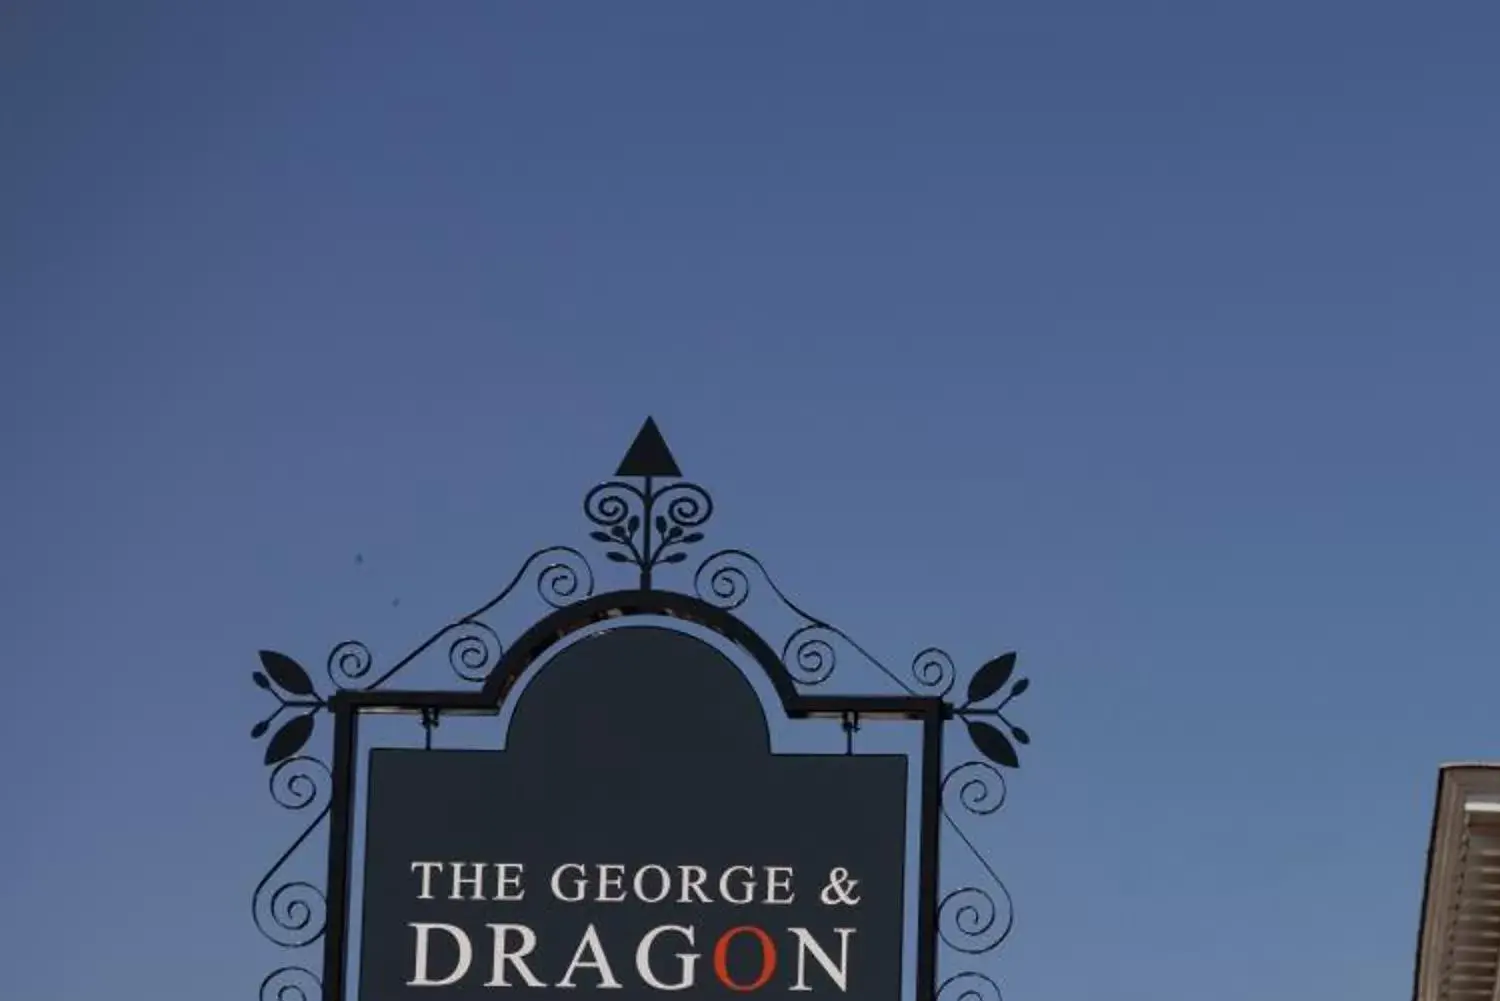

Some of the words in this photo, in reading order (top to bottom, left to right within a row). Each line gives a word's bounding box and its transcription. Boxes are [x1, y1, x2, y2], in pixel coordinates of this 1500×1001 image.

[411, 861, 525, 900] THE
[550, 863, 795, 905] GEORGE
[820, 866, 861, 906] &
[406, 922, 857, 992] DRAGON
